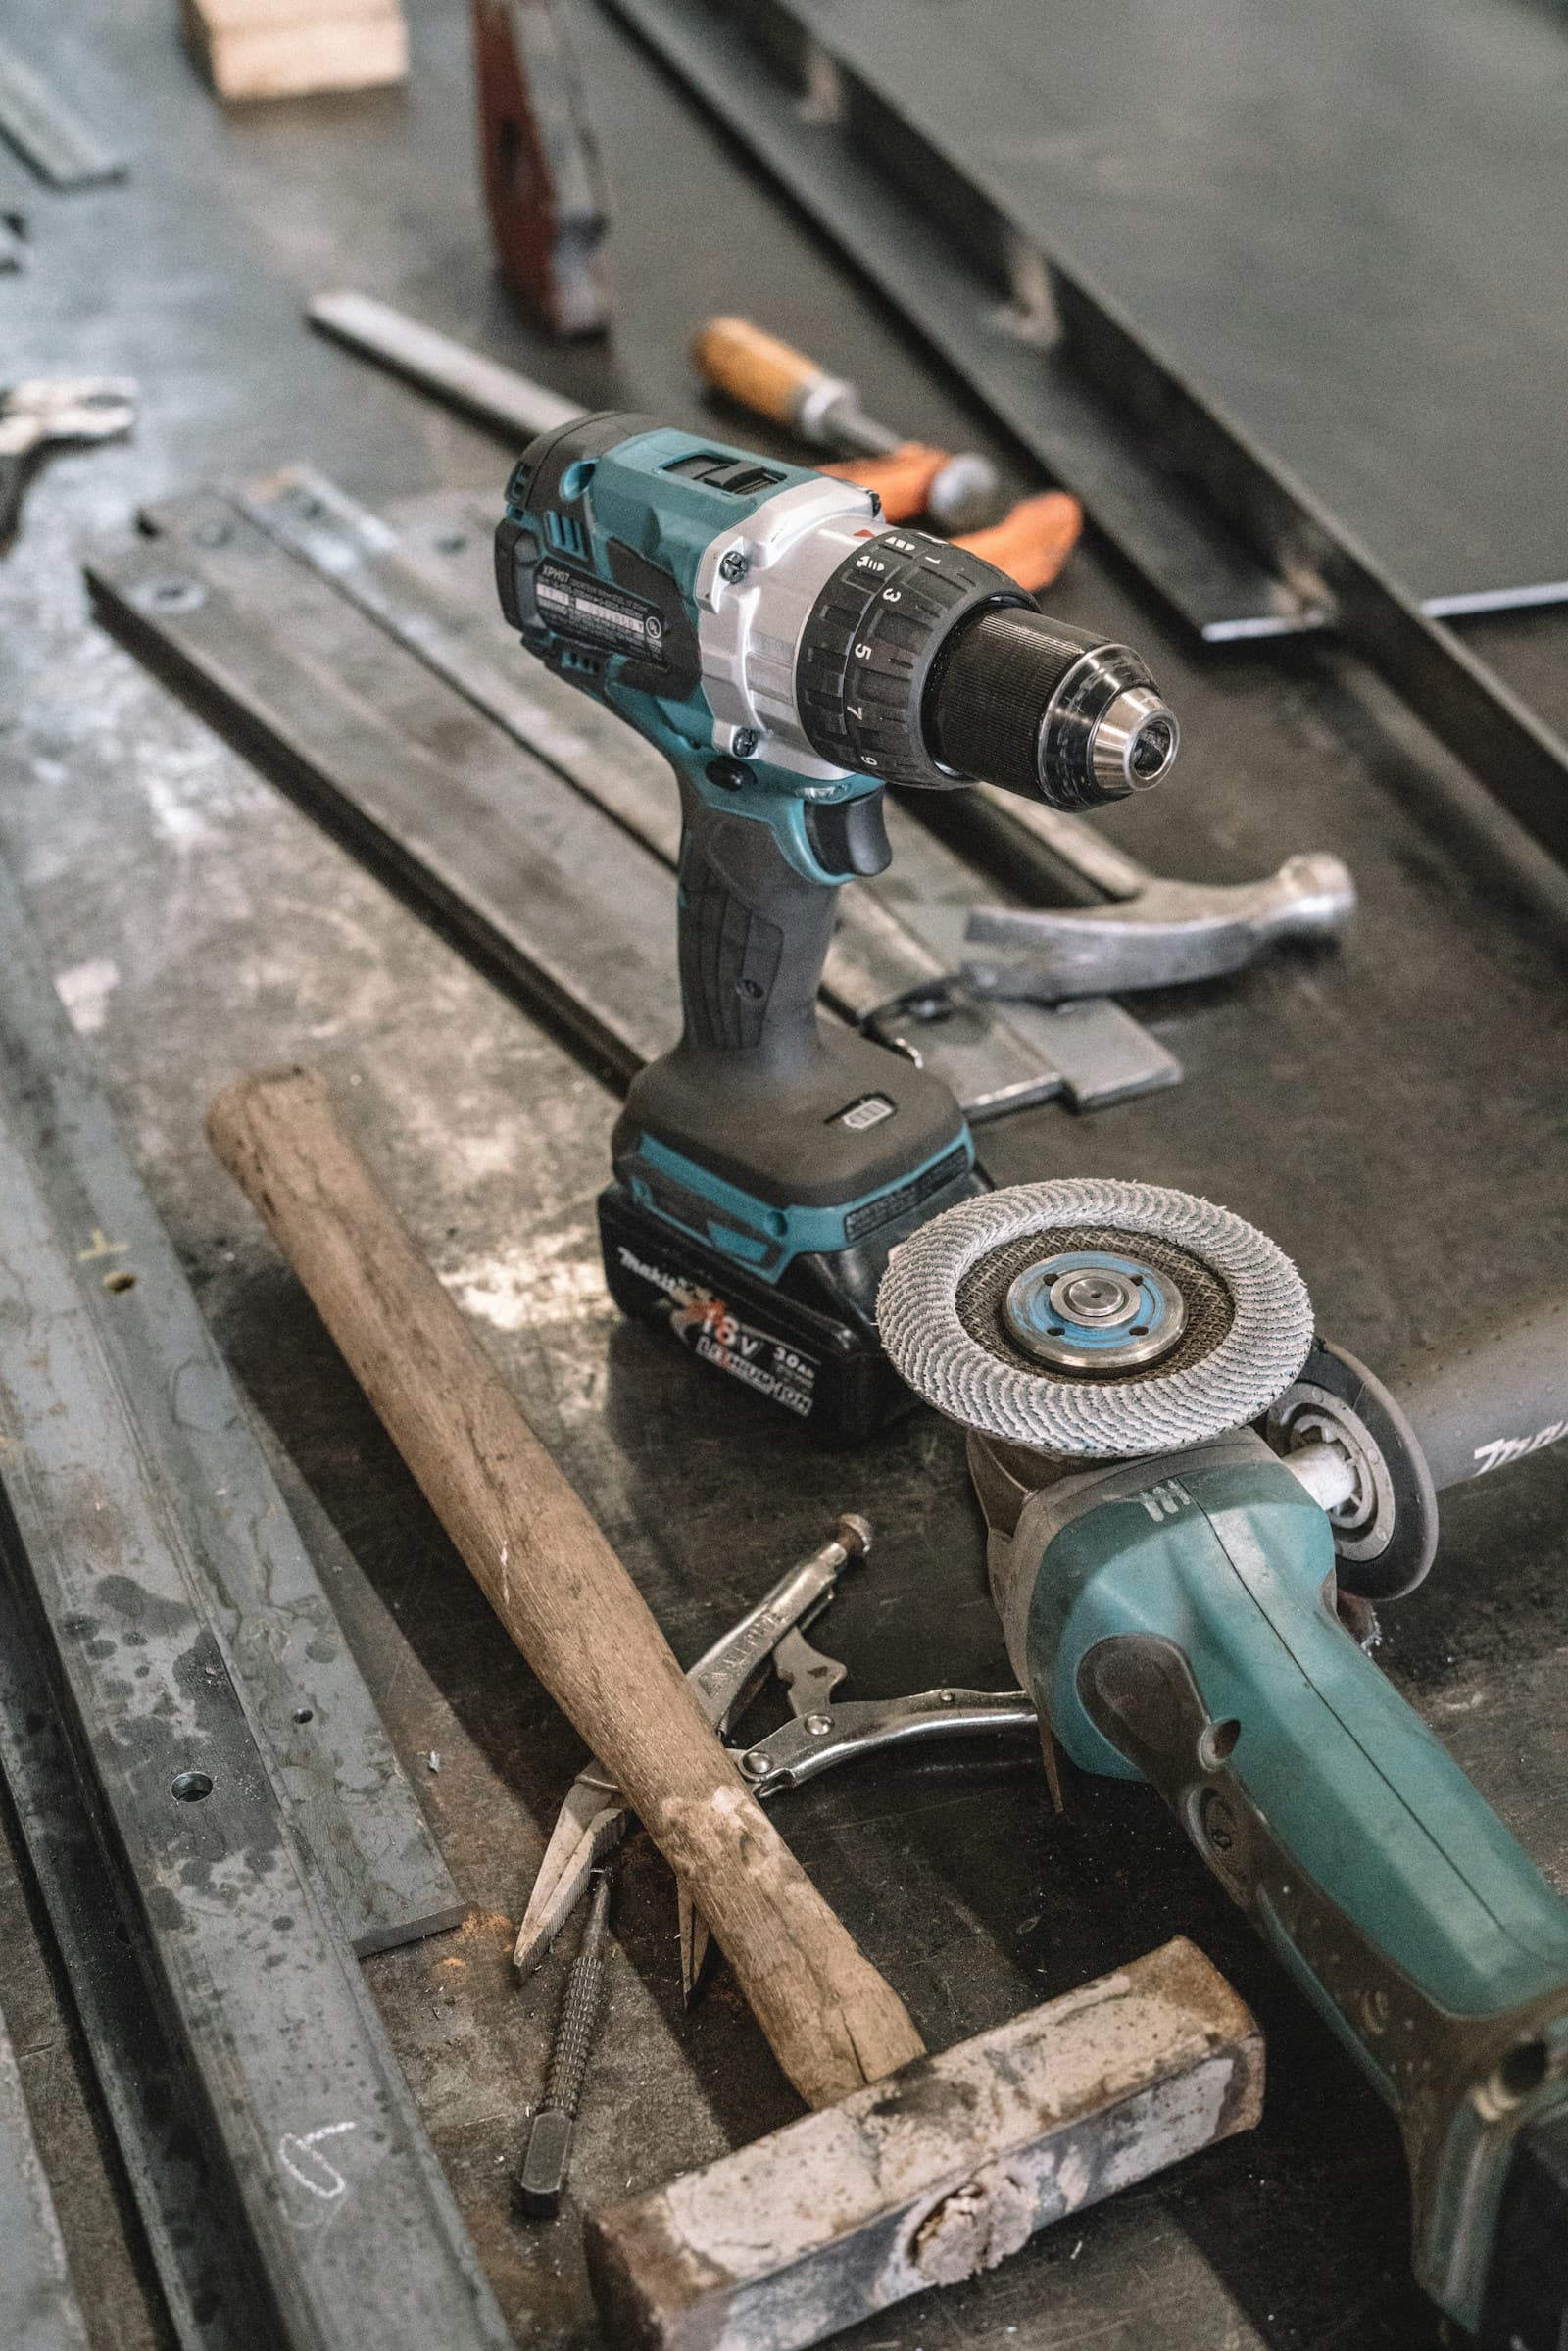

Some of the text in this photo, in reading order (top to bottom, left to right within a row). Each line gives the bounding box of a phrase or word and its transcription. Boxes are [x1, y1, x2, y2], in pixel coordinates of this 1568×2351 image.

[924, 556, 942, 565] 1
[882, 588, 902, 603] 3
[854, 643, 873, 661] 5
[846, 705, 863, 721] 7
[860, 755, 878, 767] 9
